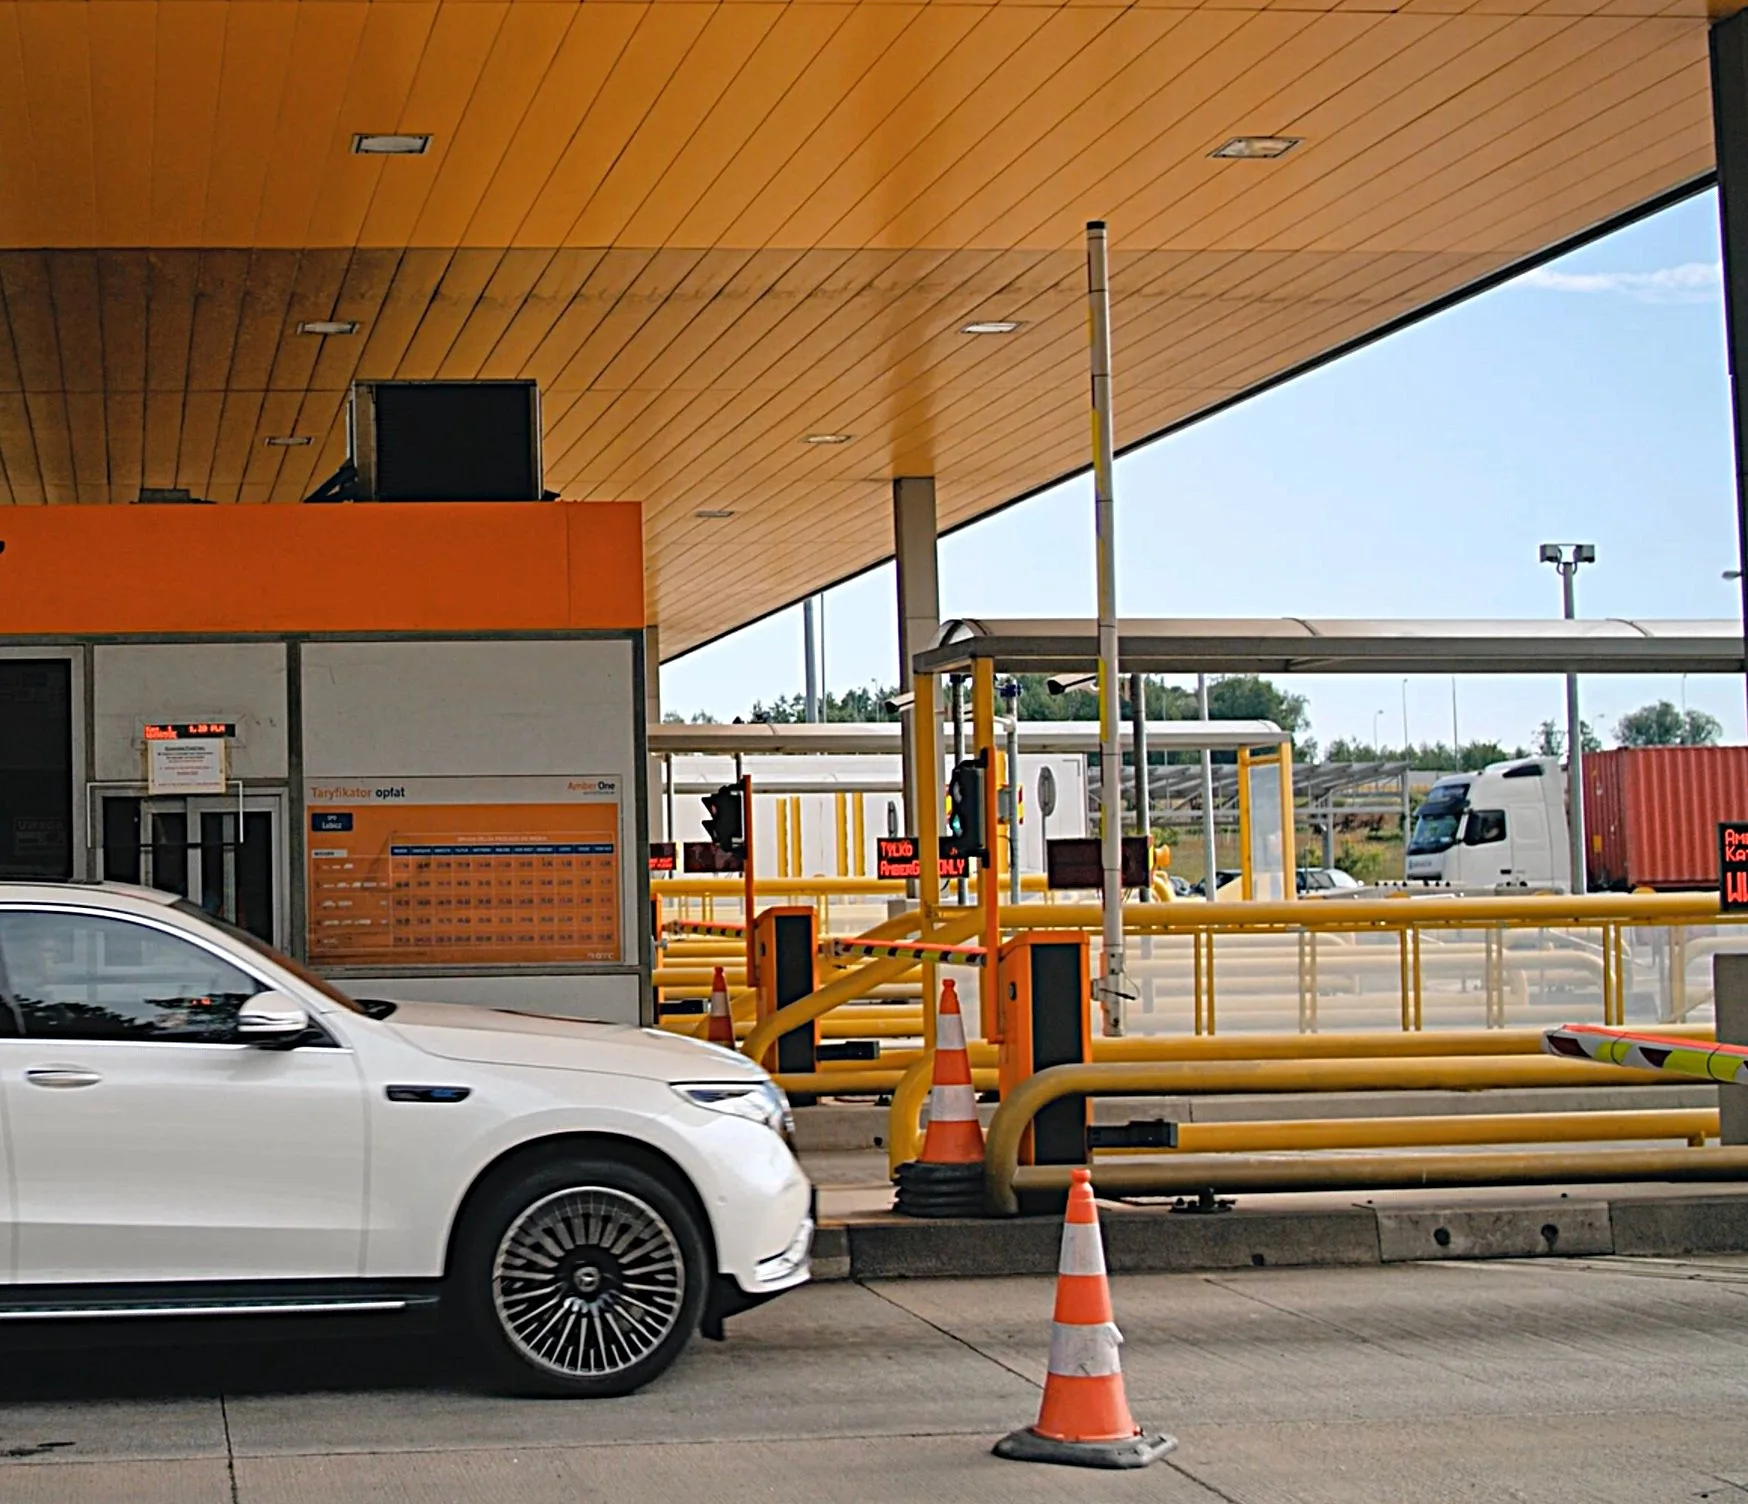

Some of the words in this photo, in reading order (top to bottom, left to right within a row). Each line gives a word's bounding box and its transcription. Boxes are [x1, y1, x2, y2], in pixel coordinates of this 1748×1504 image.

[312, 787, 372, 799] Taryfikator
[1725, 829, 1748, 845] AM
[1726, 846, 1748, 861] KA
